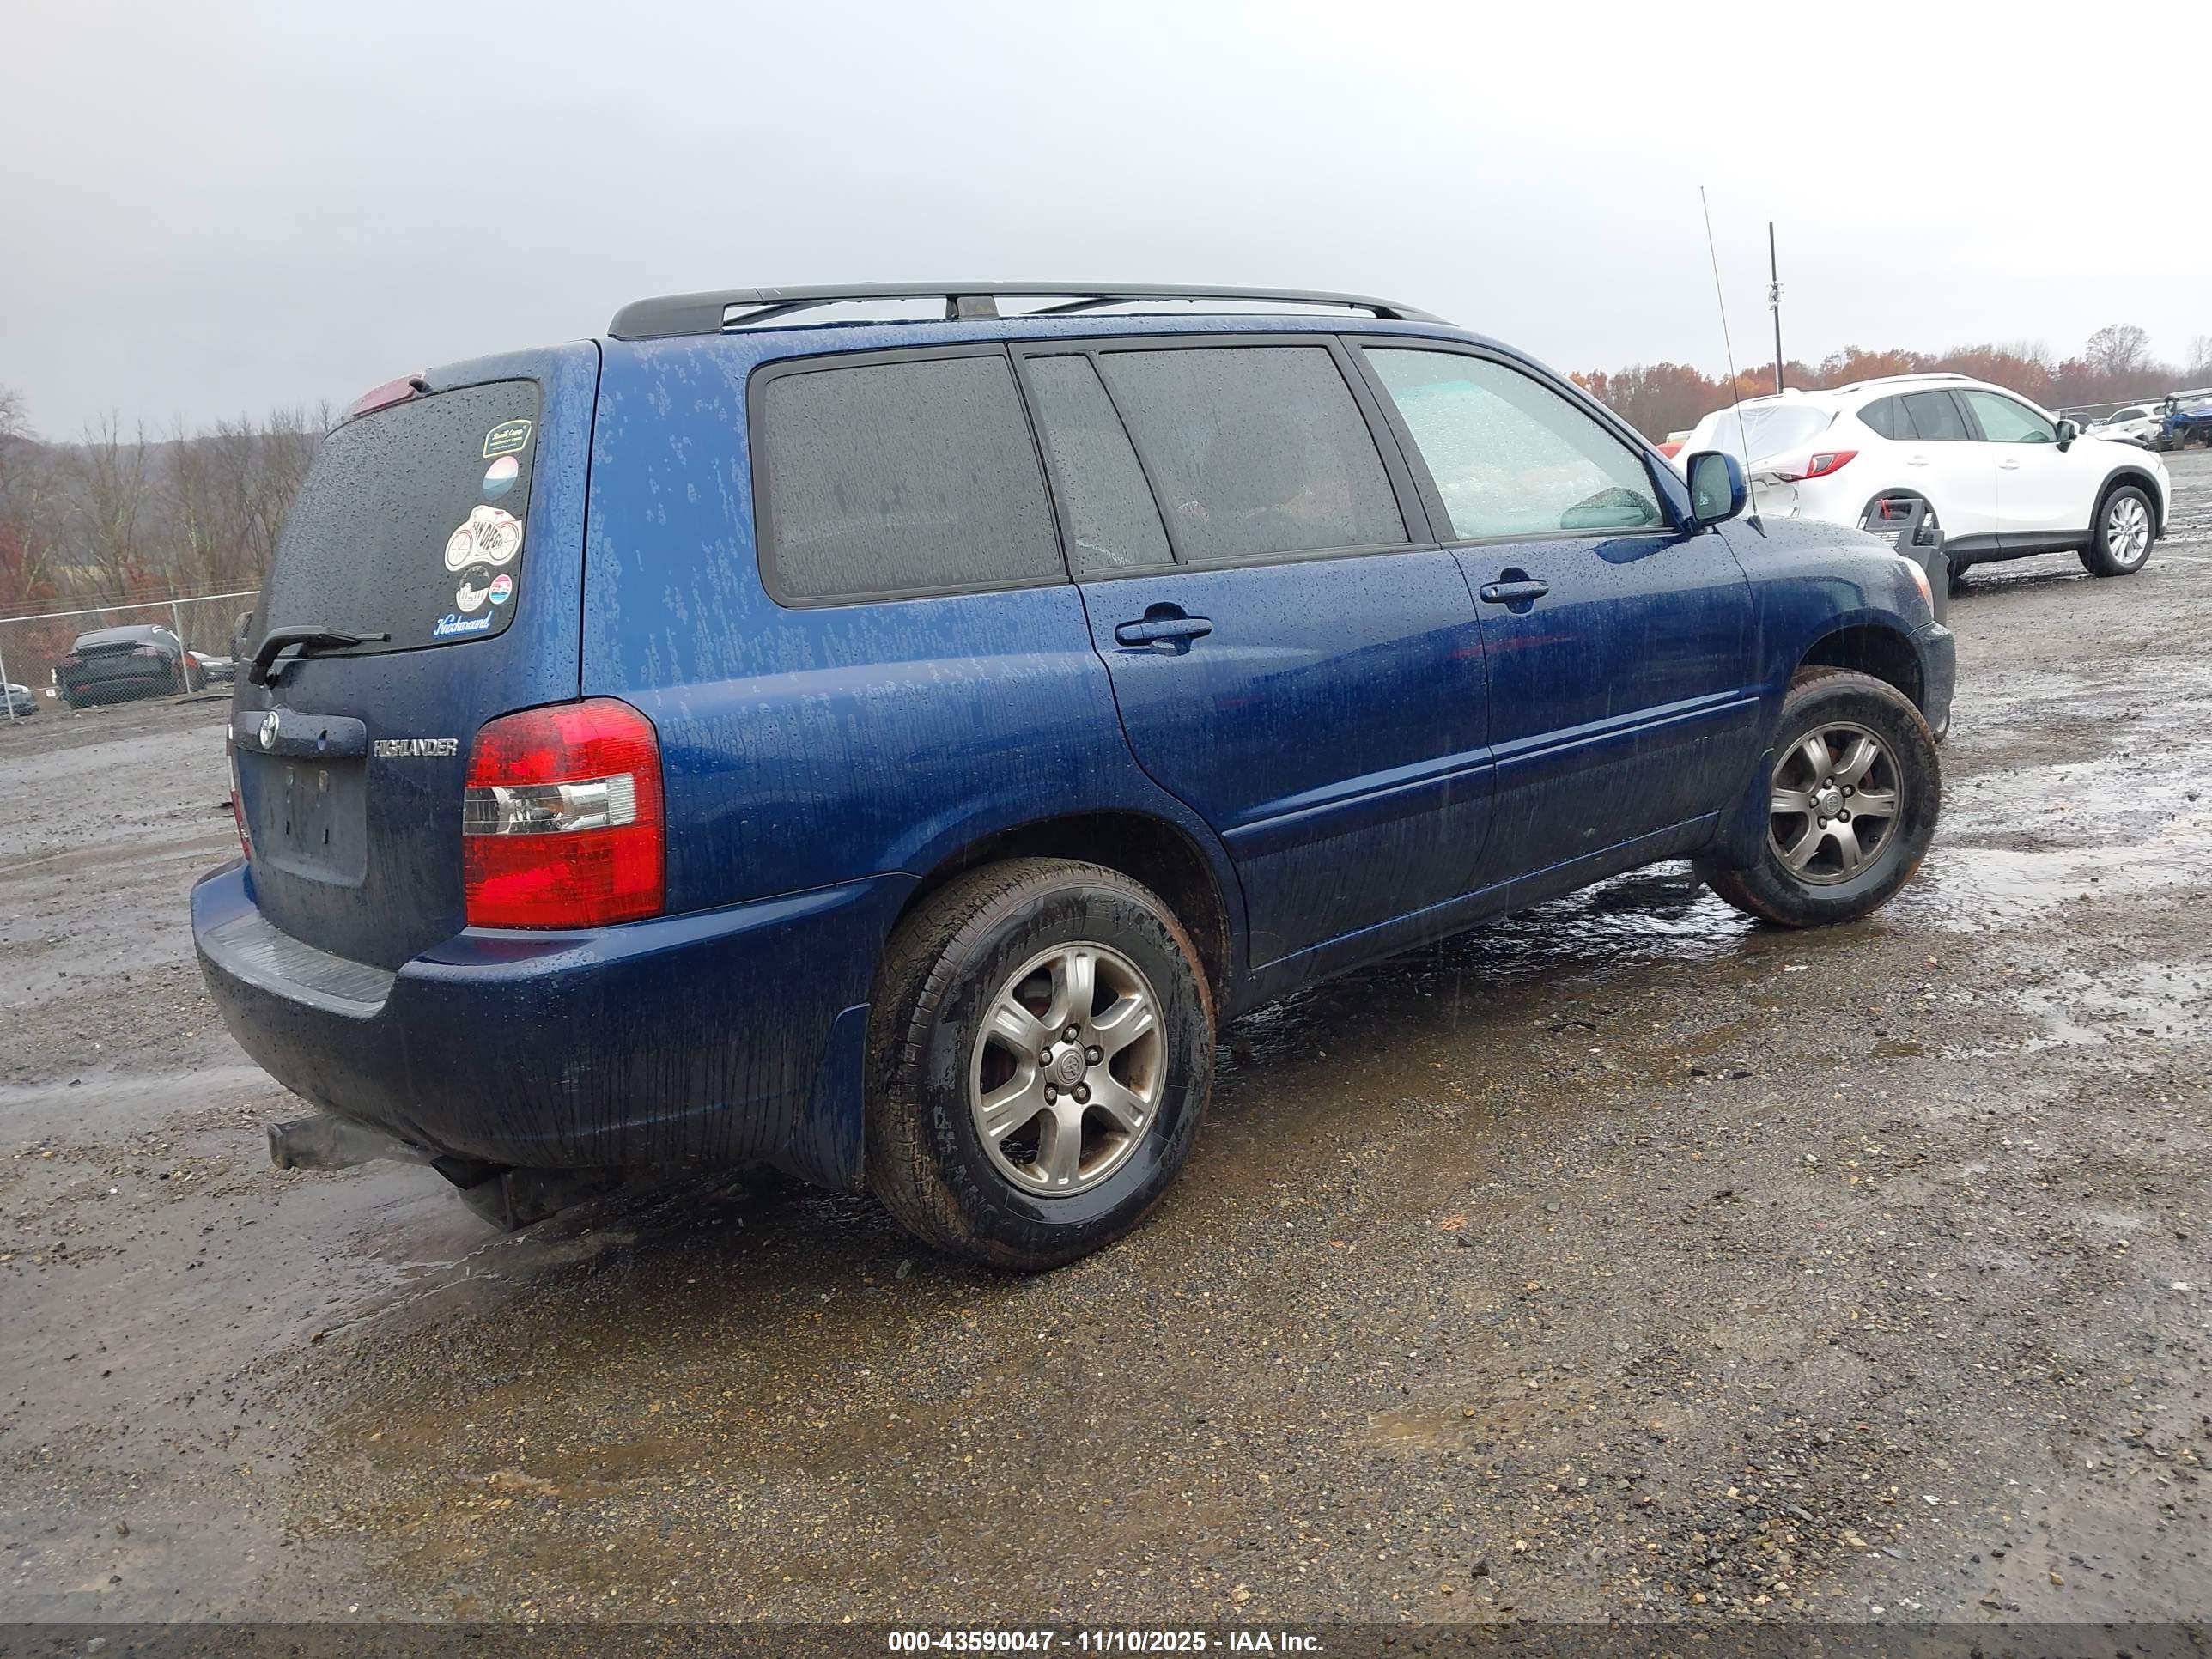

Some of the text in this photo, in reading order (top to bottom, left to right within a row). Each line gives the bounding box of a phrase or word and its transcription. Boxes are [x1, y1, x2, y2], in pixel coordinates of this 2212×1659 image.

[472, 520, 503, 550] SAN DIEGO
[374, 738, 459, 757] HIGHLANDER
